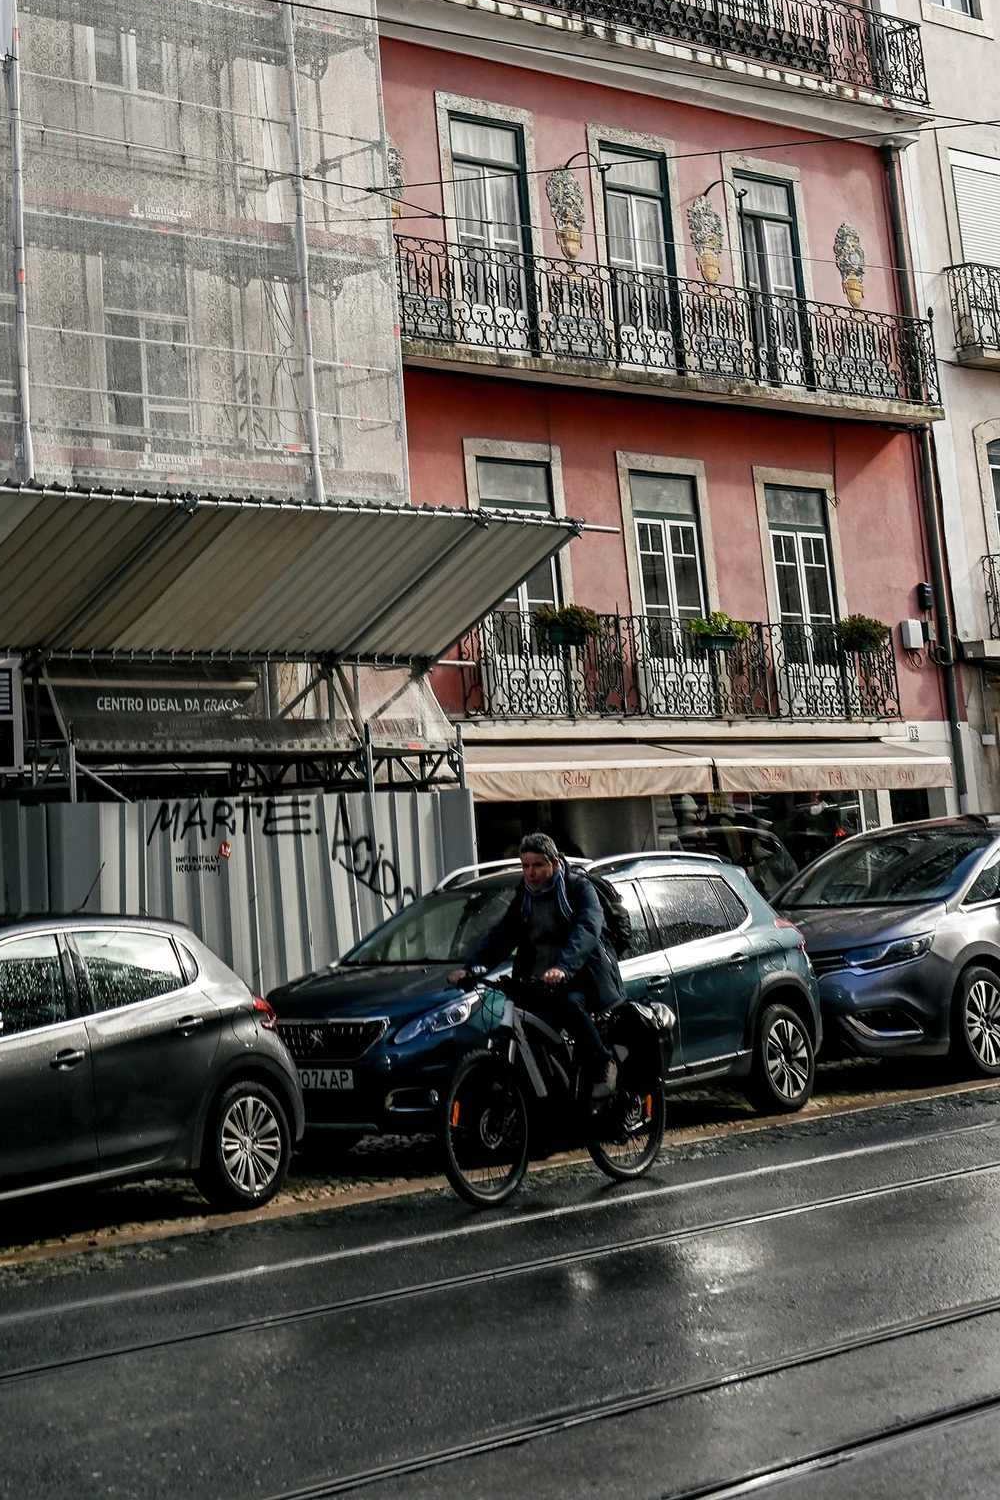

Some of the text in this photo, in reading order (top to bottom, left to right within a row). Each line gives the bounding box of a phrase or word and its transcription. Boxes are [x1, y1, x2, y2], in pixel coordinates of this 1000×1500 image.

[96, 697, 143, 711] CENTRO
[147, 698, 182, 712] IDEAL
[185, 699, 200, 712] DA
[562, 770, 590, 789] Ruby
